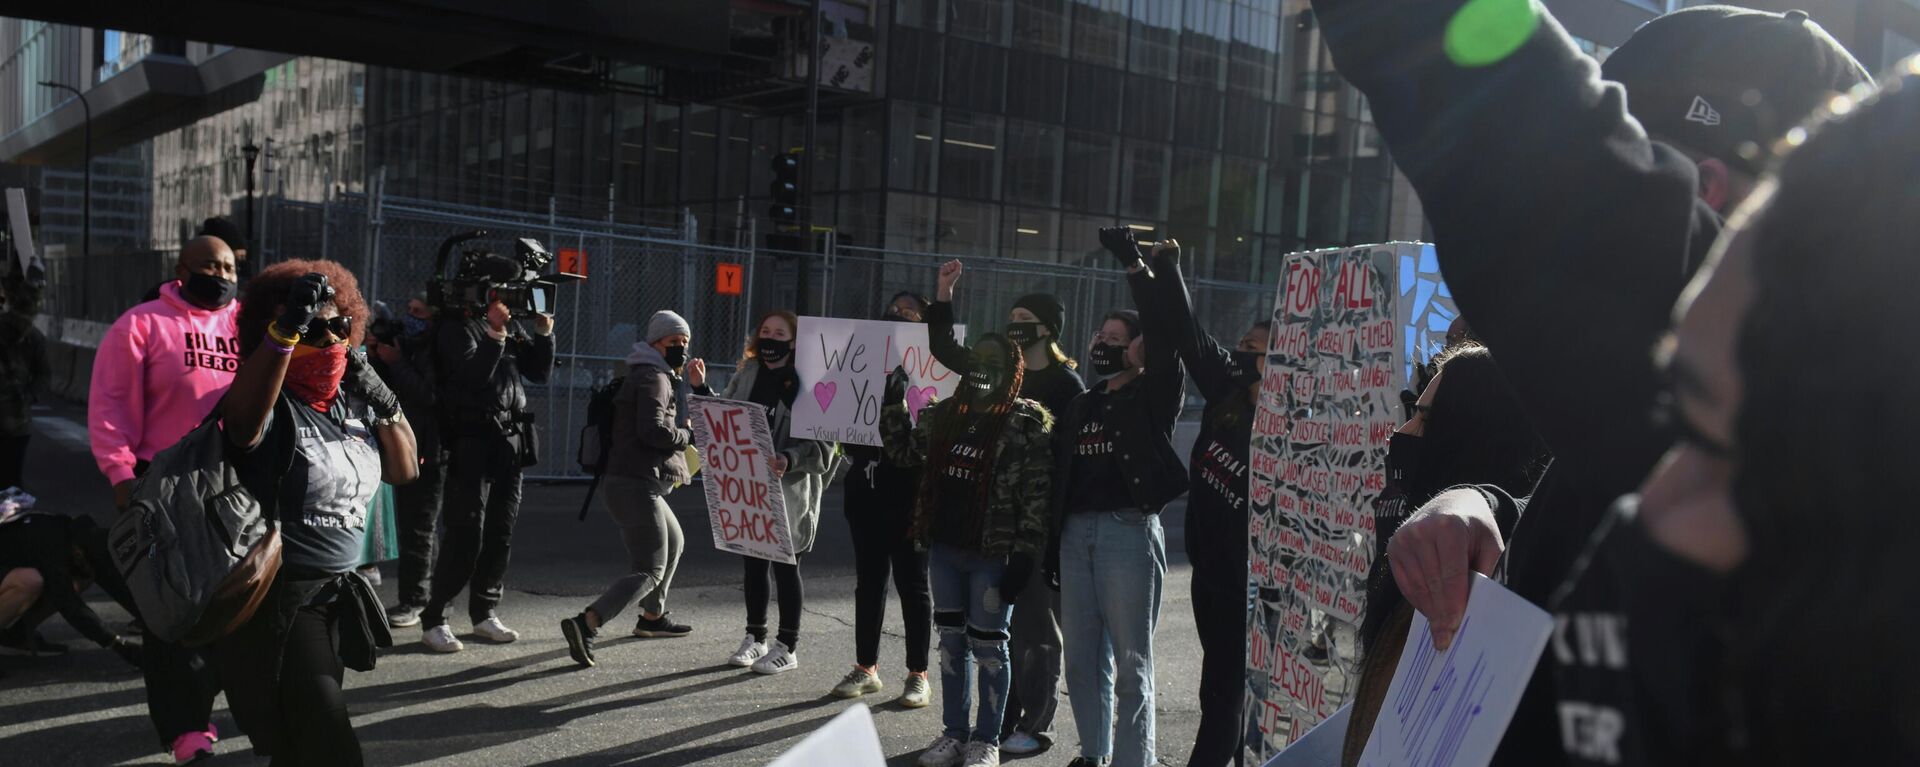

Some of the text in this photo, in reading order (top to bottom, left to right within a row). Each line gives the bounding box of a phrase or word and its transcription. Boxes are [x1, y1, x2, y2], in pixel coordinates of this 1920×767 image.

[726, 271, 734, 288] Y
[1285, 261, 1374, 317] FOR ALL
[184, 332, 241, 355] BLAC
[820, 332, 868, 374] We
[1275, 325, 1308, 358] WHO
[184, 352, 238, 372] HERO
[850, 378, 883, 426] Yo
[1294, 374, 1315, 397] GET
[1319, 376, 1326, 394] A
[704, 408, 751, 446] WE
[846, 427, 876, 445] Black
[1332, 420, 1364, 447] WHOSE
[707, 443, 758, 477] GOT
[714, 474, 772, 511] YOUR
[1201, 467, 1245, 510] JUSTICE
[1300, 464, 1329, 494] CASES
[1335, 471, 1360, 492] THAT
[1363, 472, 1384, 491] WERE
[1250, 478, 1272, 503] SWEPT
[1277, 493, 1296, 513] UNDER
[1298, 498, 1311, 516] THE
[1335, 507, 1354, 526] WHO
[719, 508, 780, 544] BACK
[1251, 516, 1265, 539] GET
[1278, 530, 1306, 554] NATIONAL
[1346, 551, 1367, 574] AND
[1251, 554, 1269, 578] WHOSE
[1315, 584, 1332, 607] BURN
[1338, 596, 1359, 617] FROM
[1282, 609, 1305, 632] GRIEF
[1250, 628, 1269, 671] YOU
[1271, 643, 1328, 720] DESERVE
[1259, 699, 1282, 735] IT
